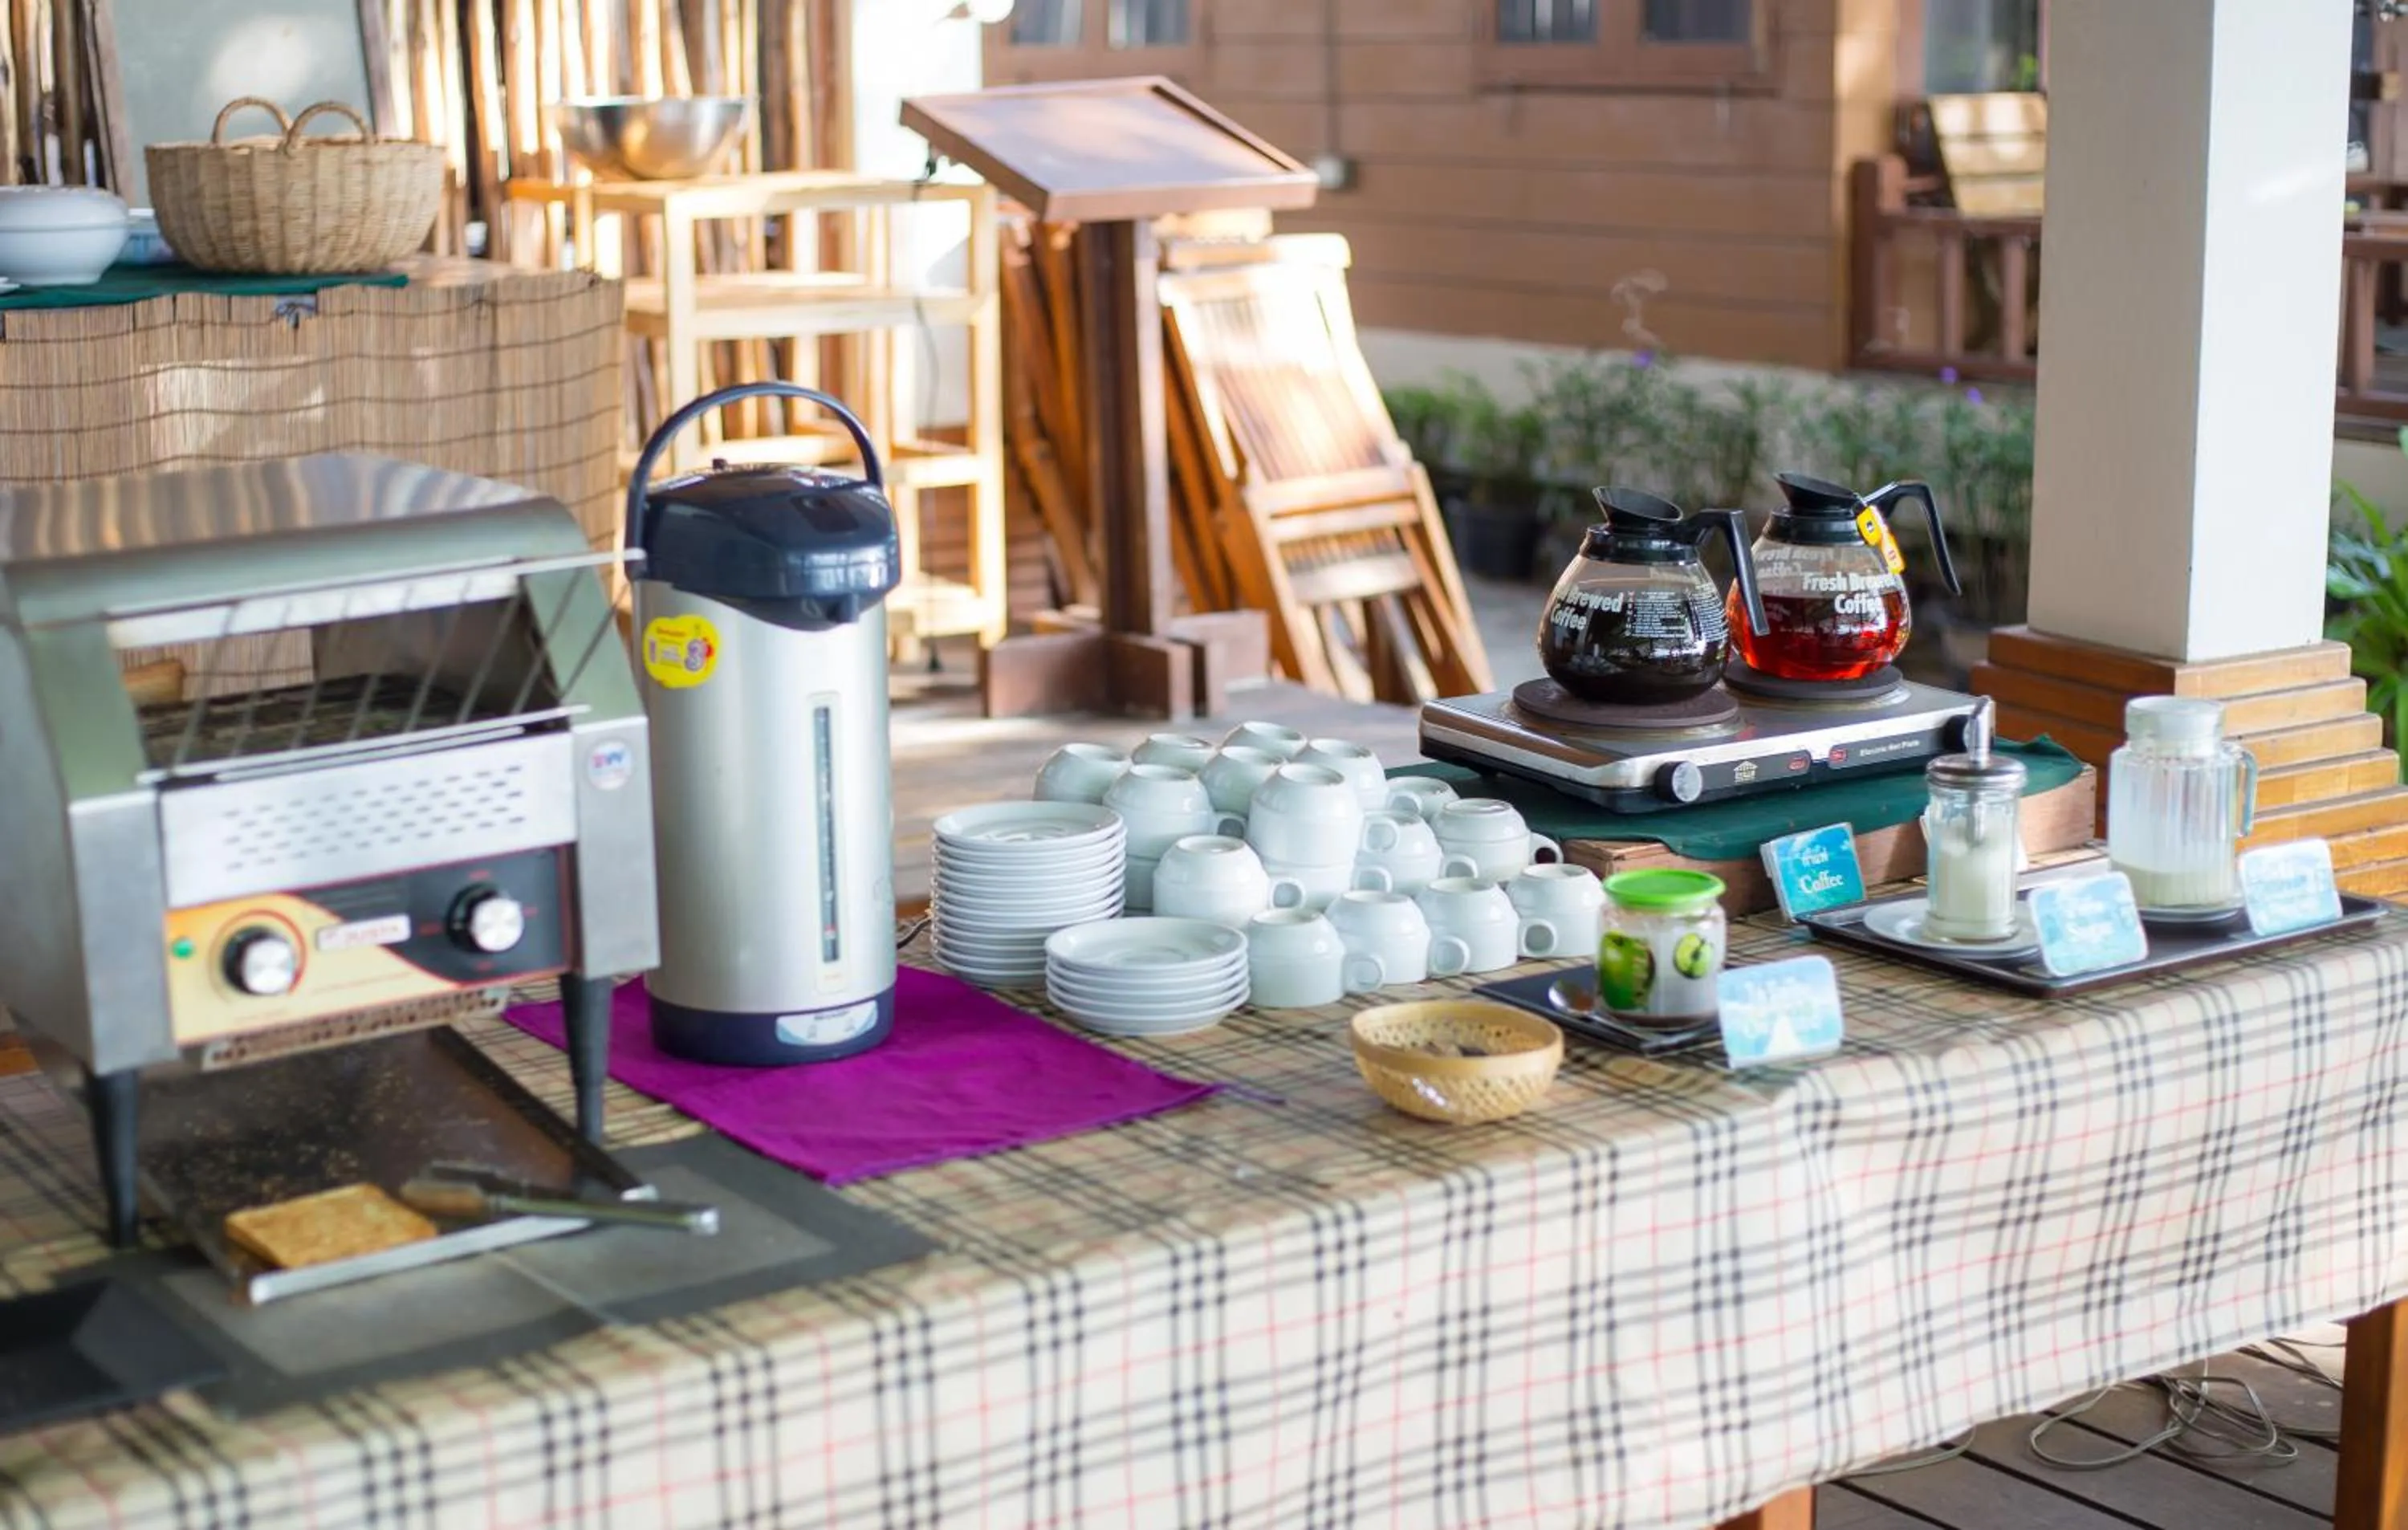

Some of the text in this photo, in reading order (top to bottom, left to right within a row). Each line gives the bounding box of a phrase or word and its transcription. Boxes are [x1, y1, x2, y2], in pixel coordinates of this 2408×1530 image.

[1803, 571, 1848, 592] Fresh
[1835, 592, 1882, 615] Coffee
[1551, 604, 1587, 630] Coffee
[1799, 869, 1844, 893] Coffee
